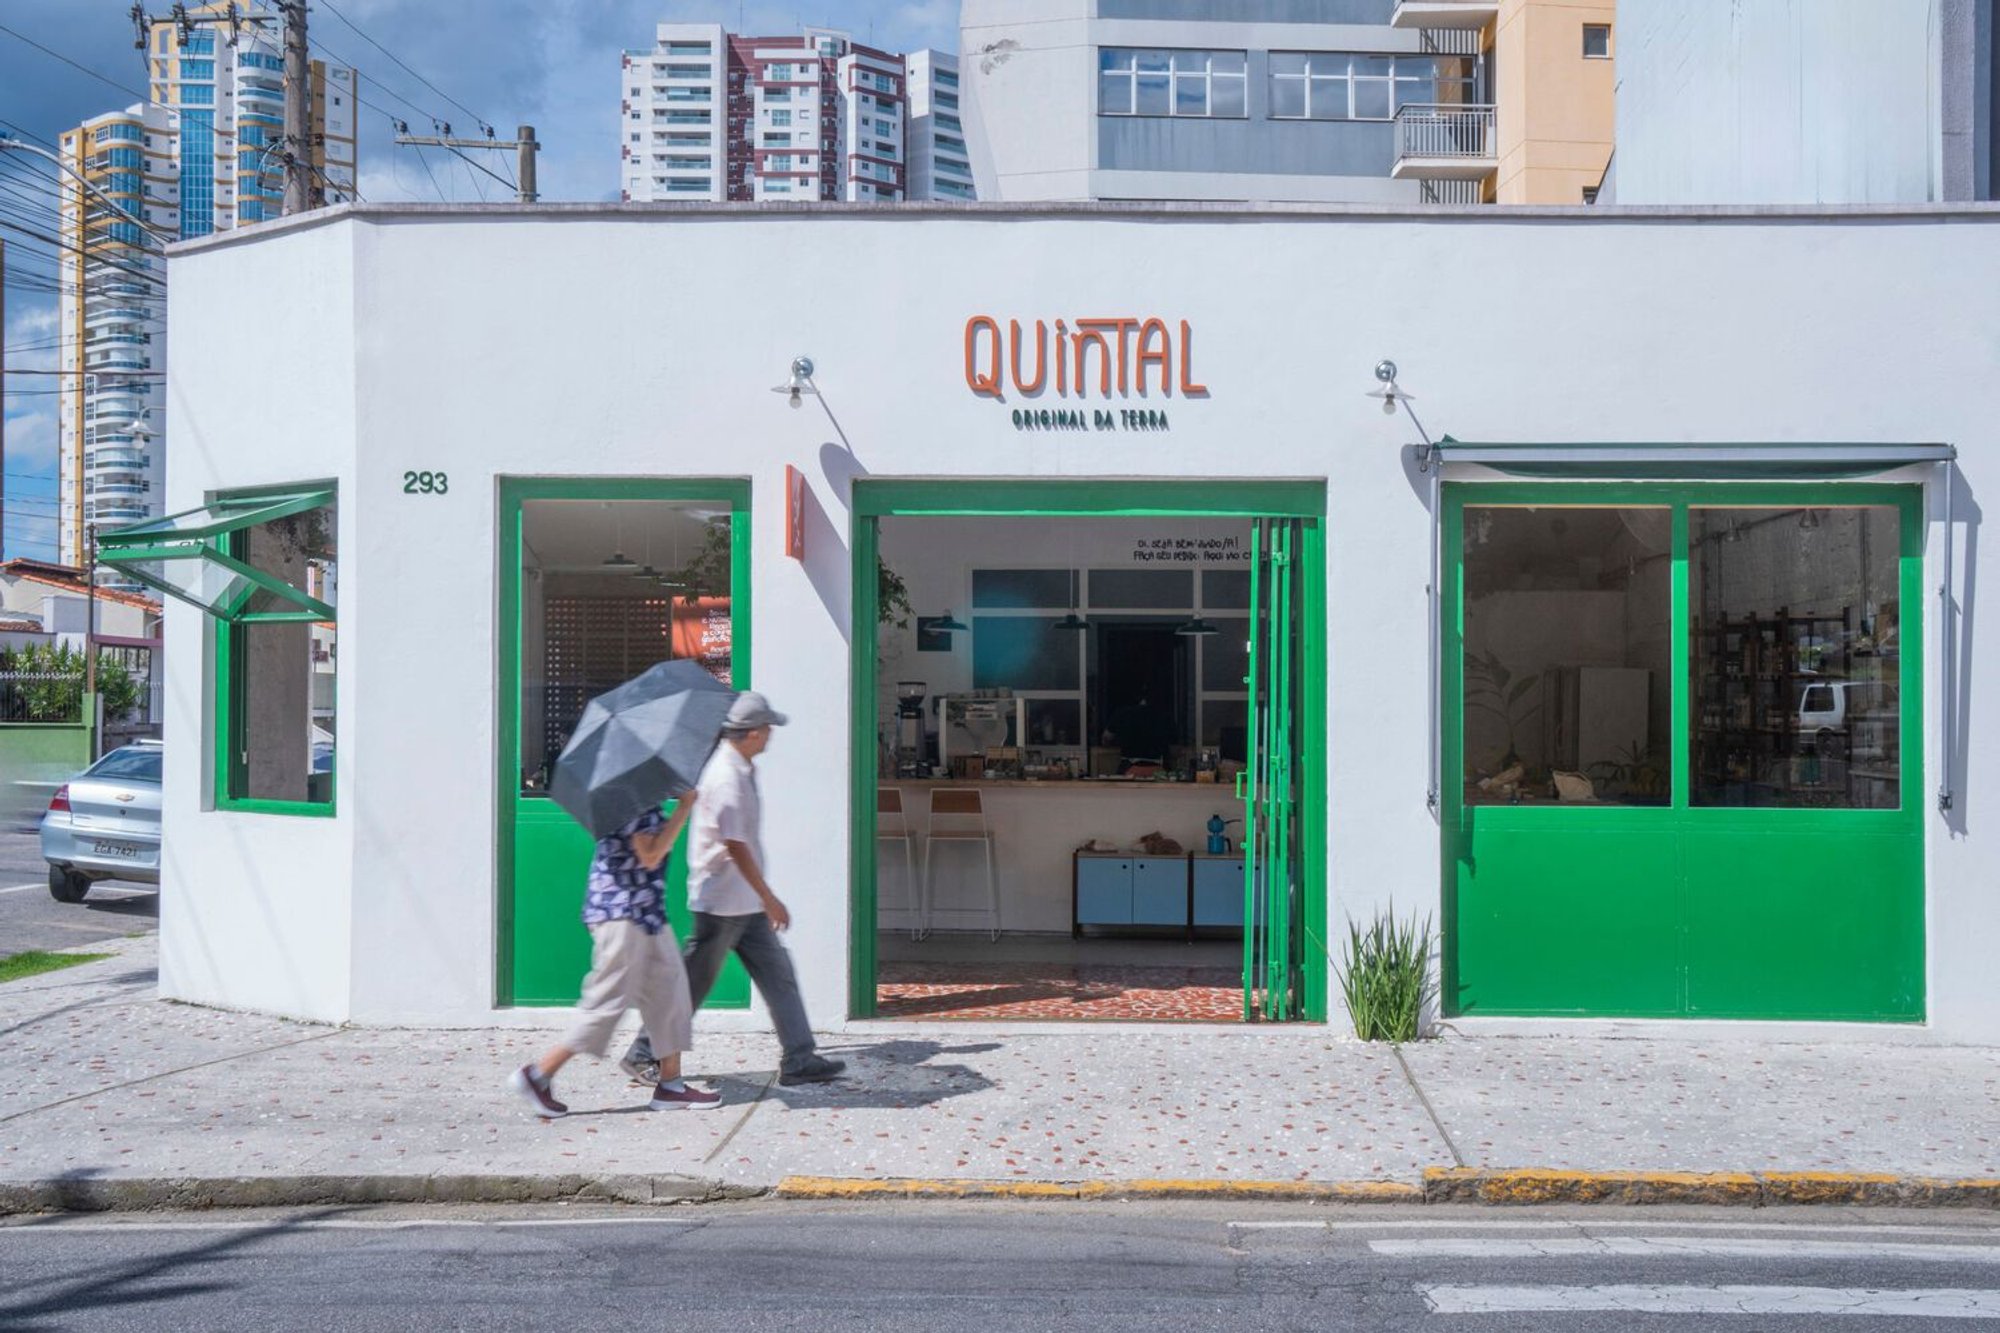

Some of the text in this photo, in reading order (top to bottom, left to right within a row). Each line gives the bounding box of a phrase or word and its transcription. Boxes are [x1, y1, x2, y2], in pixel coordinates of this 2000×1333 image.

[1012, 409, 1168, 428] ORIGINAL DA TERRA
[403, 471, 448, 495] 293
[1133, 551, 1154, 561] FAÇA
[1156, 551, 1171, 560] SEU
